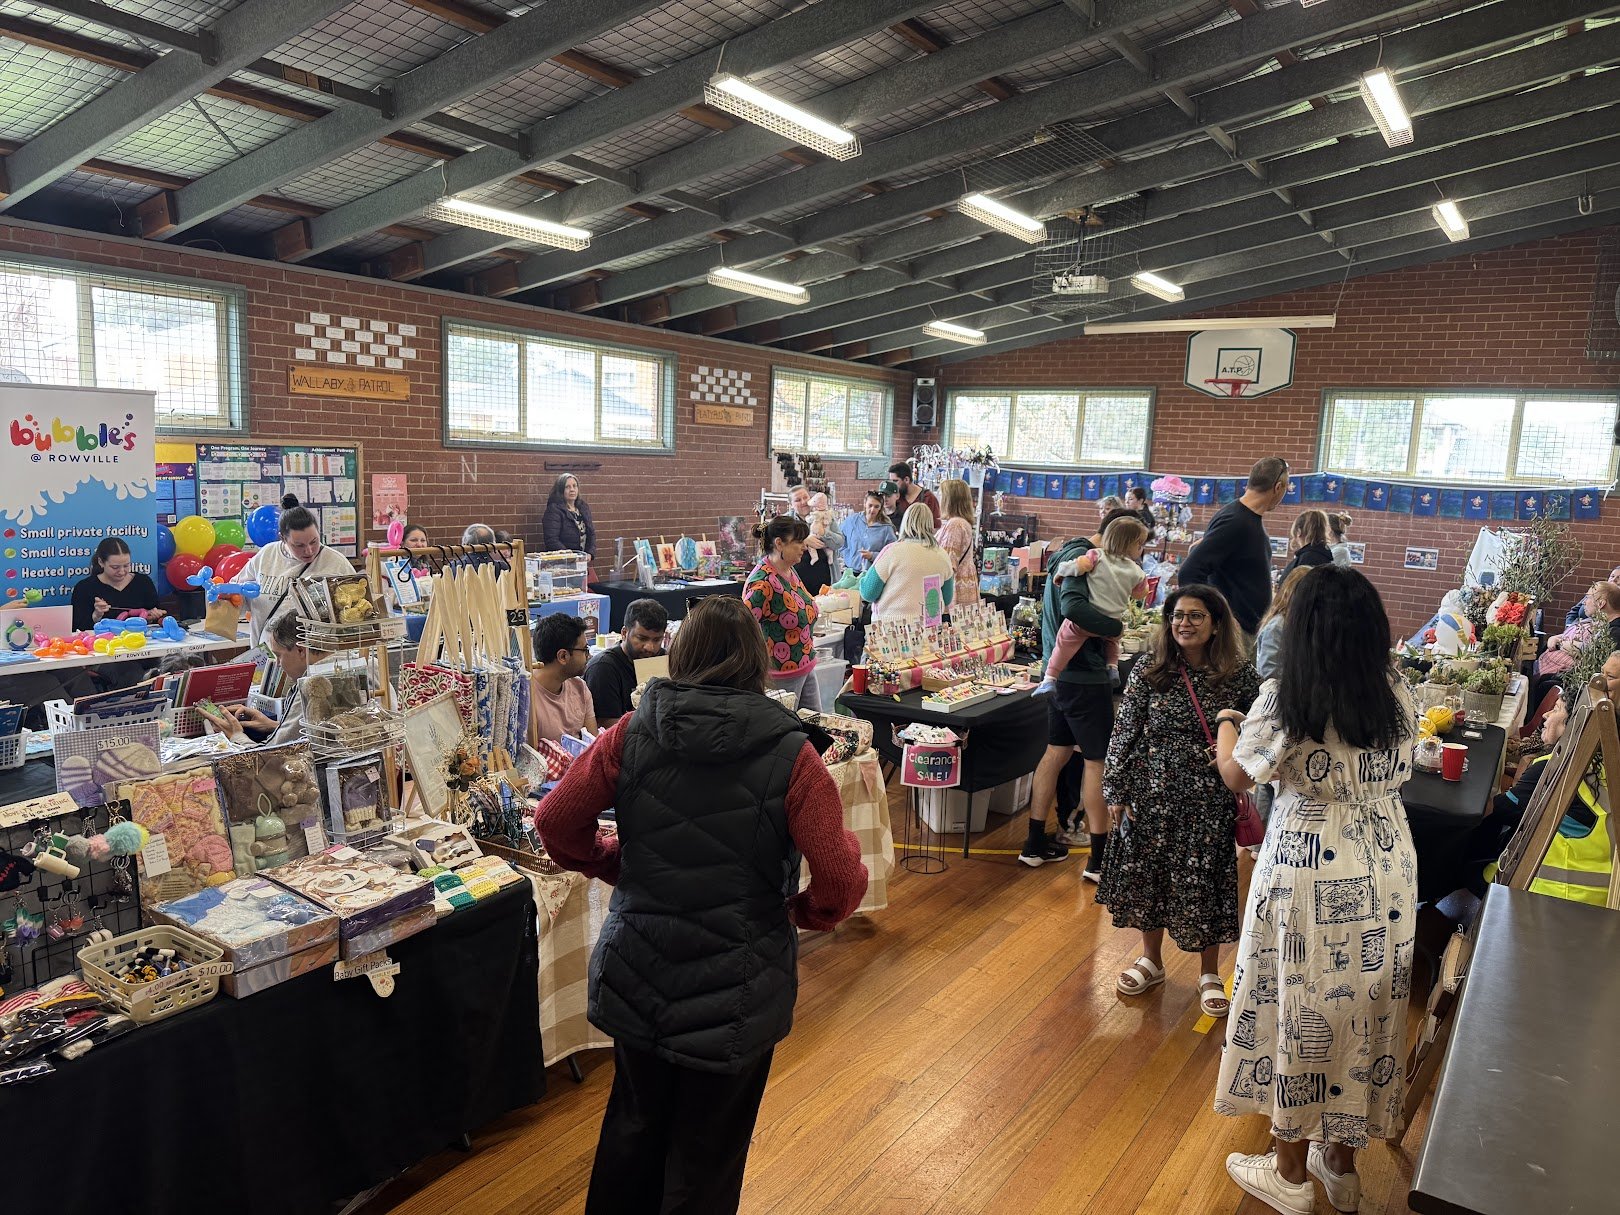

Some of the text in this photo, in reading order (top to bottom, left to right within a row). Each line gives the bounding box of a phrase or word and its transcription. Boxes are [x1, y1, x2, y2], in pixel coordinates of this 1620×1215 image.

[292, 374, 394, 393] WALLABY PATROL
[10, 415, 137, 451] bubbles
[30, 453, 119, 463] @ ROWVILLE
[20, 525, 149, 540] Small private facility
[20, 546, 91, 559] Small class
[21, 566, 65, 578] Heated
[67, 566, 92, 578] poo
[509, 611, 524, 623] 25
[97, 736, 130, 749] $15.00
[908, 752, 957, 766] Clearance
[916, 770, 943, 782] SALE
[198, 963, 233, 977] $10.00
[334, 968, 354, 981] Baby
[354, 963, 369, 975] Gift
[370, 958, 392, 970] Packs
